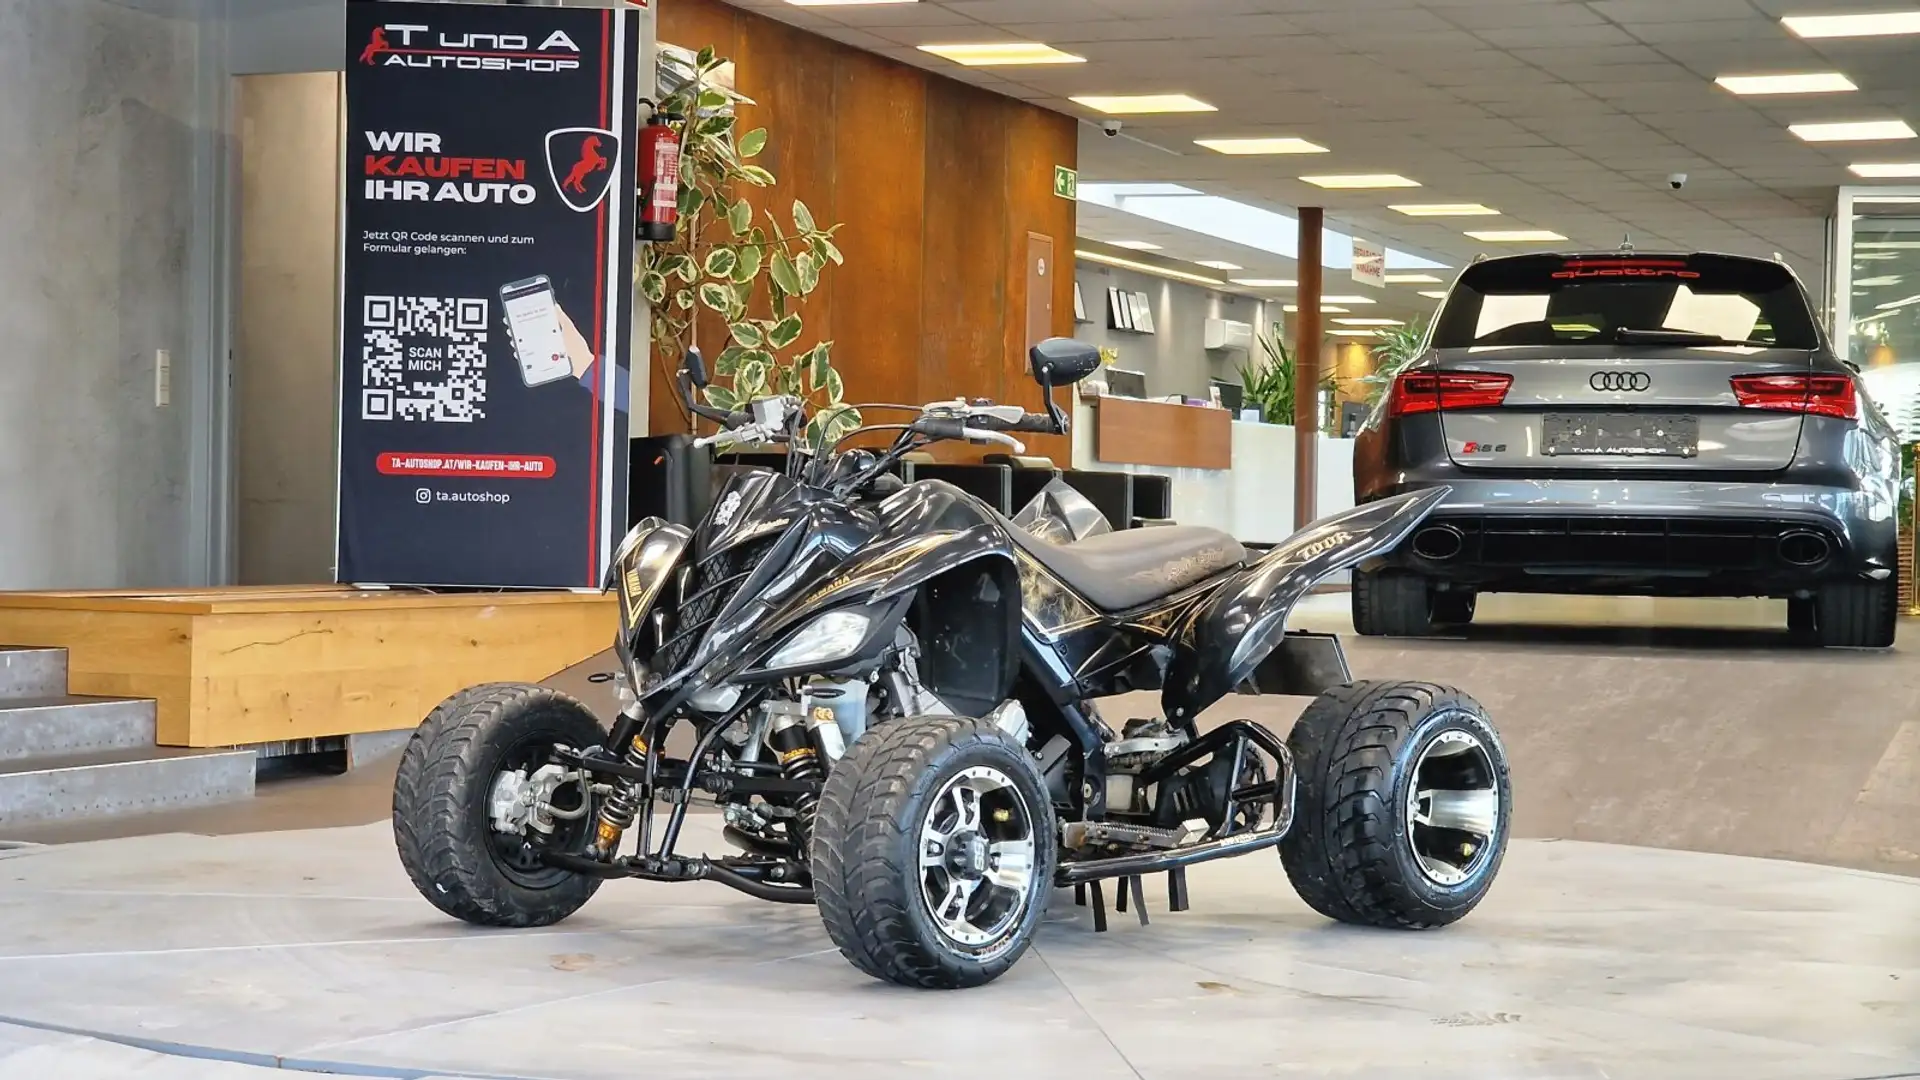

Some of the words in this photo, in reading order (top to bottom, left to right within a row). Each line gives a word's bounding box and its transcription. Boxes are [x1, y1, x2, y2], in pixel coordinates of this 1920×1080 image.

[384, 24, 429, 46] T
[536, 29, 581, 52] A
[384, 54, 580, 72] AUTOSHOP
[364, 130, 442, 153] WIR
[365, 154, 526, 180] KAUFEN
[365, 179, 430, 201] IHR
[433, 181, 537, 205] AUTO
[362, 230, 389, 240] Jetzt
[391, 231, 409, 241] QR
[410, 231, 438, 242] Code
[440, 233, 485, 243] scannen
[487, 234, 509, 244] und
[511, 236, 535, 245] zum
[363, 242, 412, 253] Formular
[414, 244, 467, 256] gelangen:
[1551, 268, 1700, 279] quattro
[408, 346, 442, 359] SCAN
[408, 359, 442, 371] MICH
[435, 490, 510, 504] ta.autoshop
